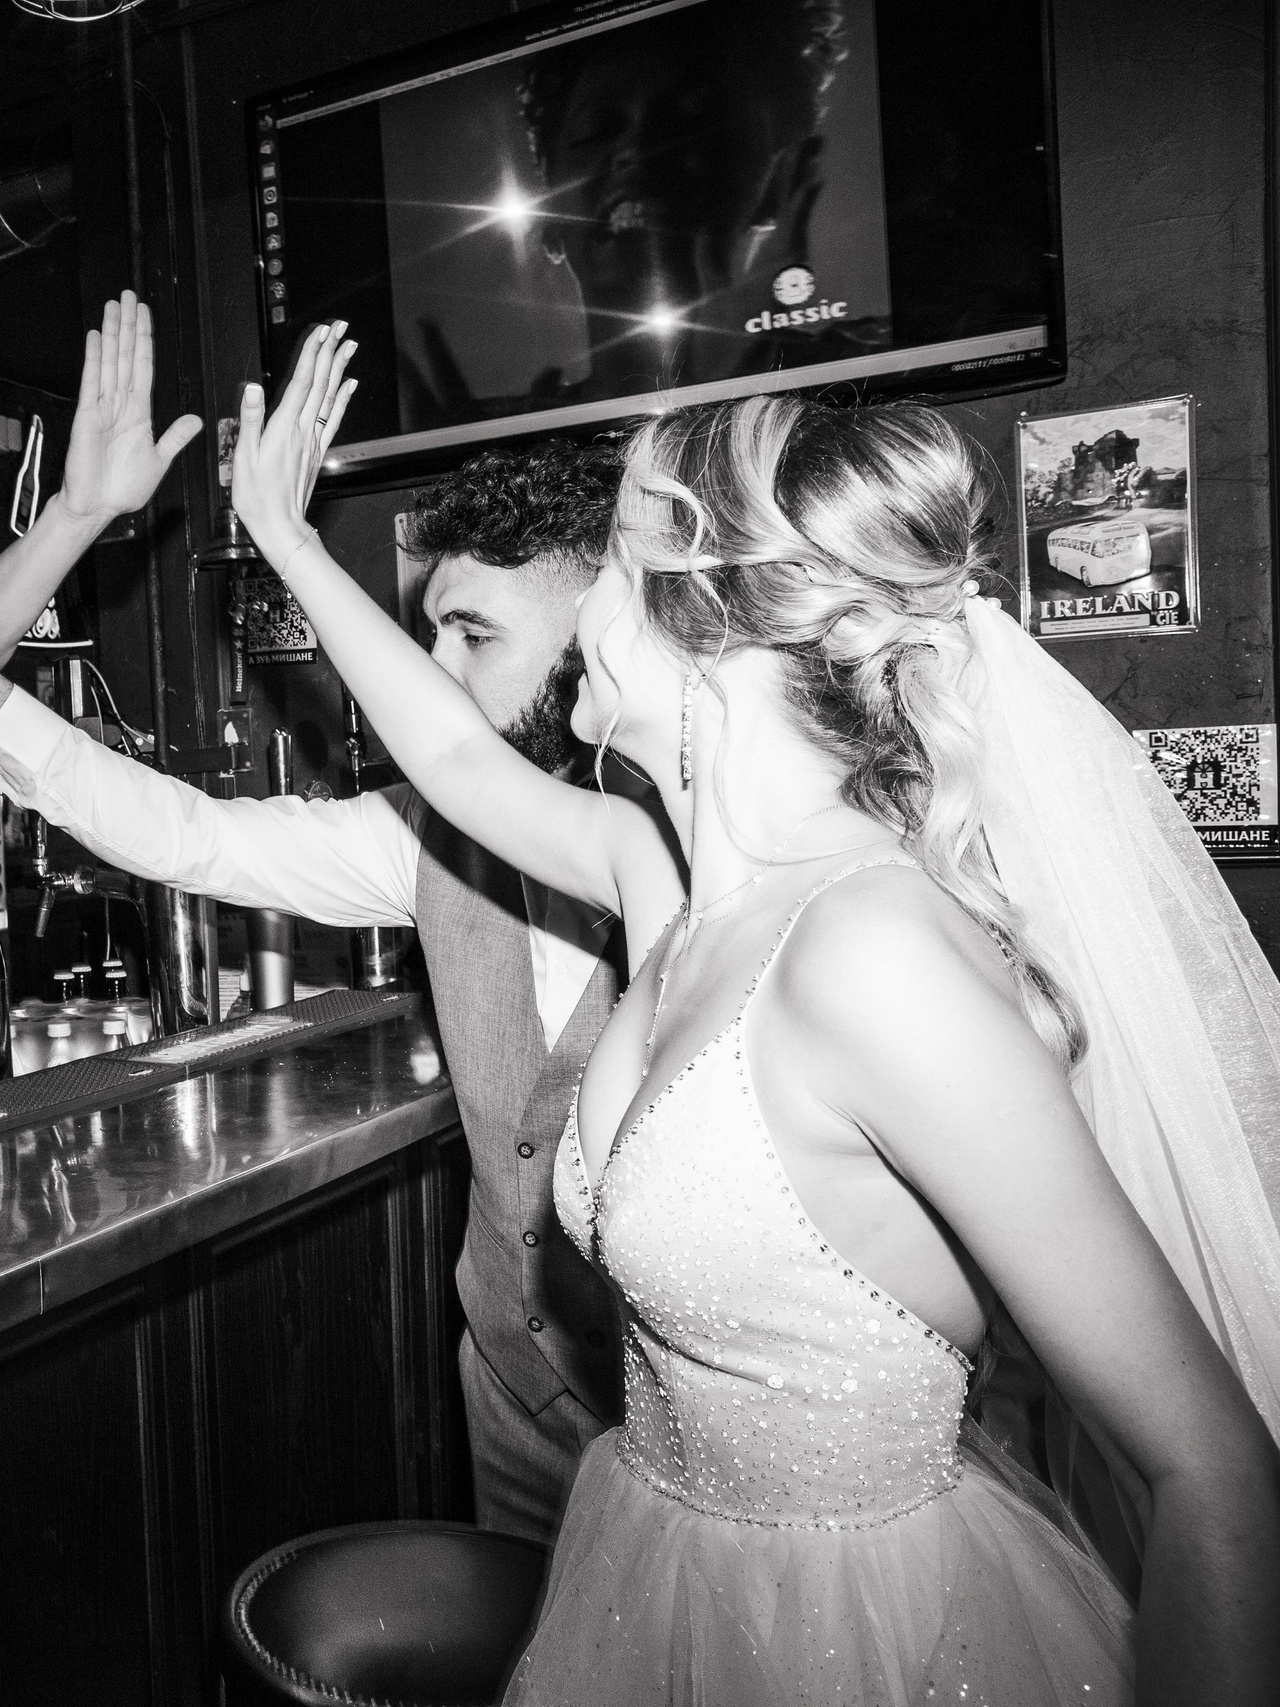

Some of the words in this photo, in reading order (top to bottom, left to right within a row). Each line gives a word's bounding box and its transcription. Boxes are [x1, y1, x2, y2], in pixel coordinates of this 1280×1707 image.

[745, 299, 848, 333] classic
[1039, 589, 1180, 619] IRELAND
[271, 651, 314, 663] МИШАНЕ
[1197, 830, 1270, 842] МИШАНЕ
